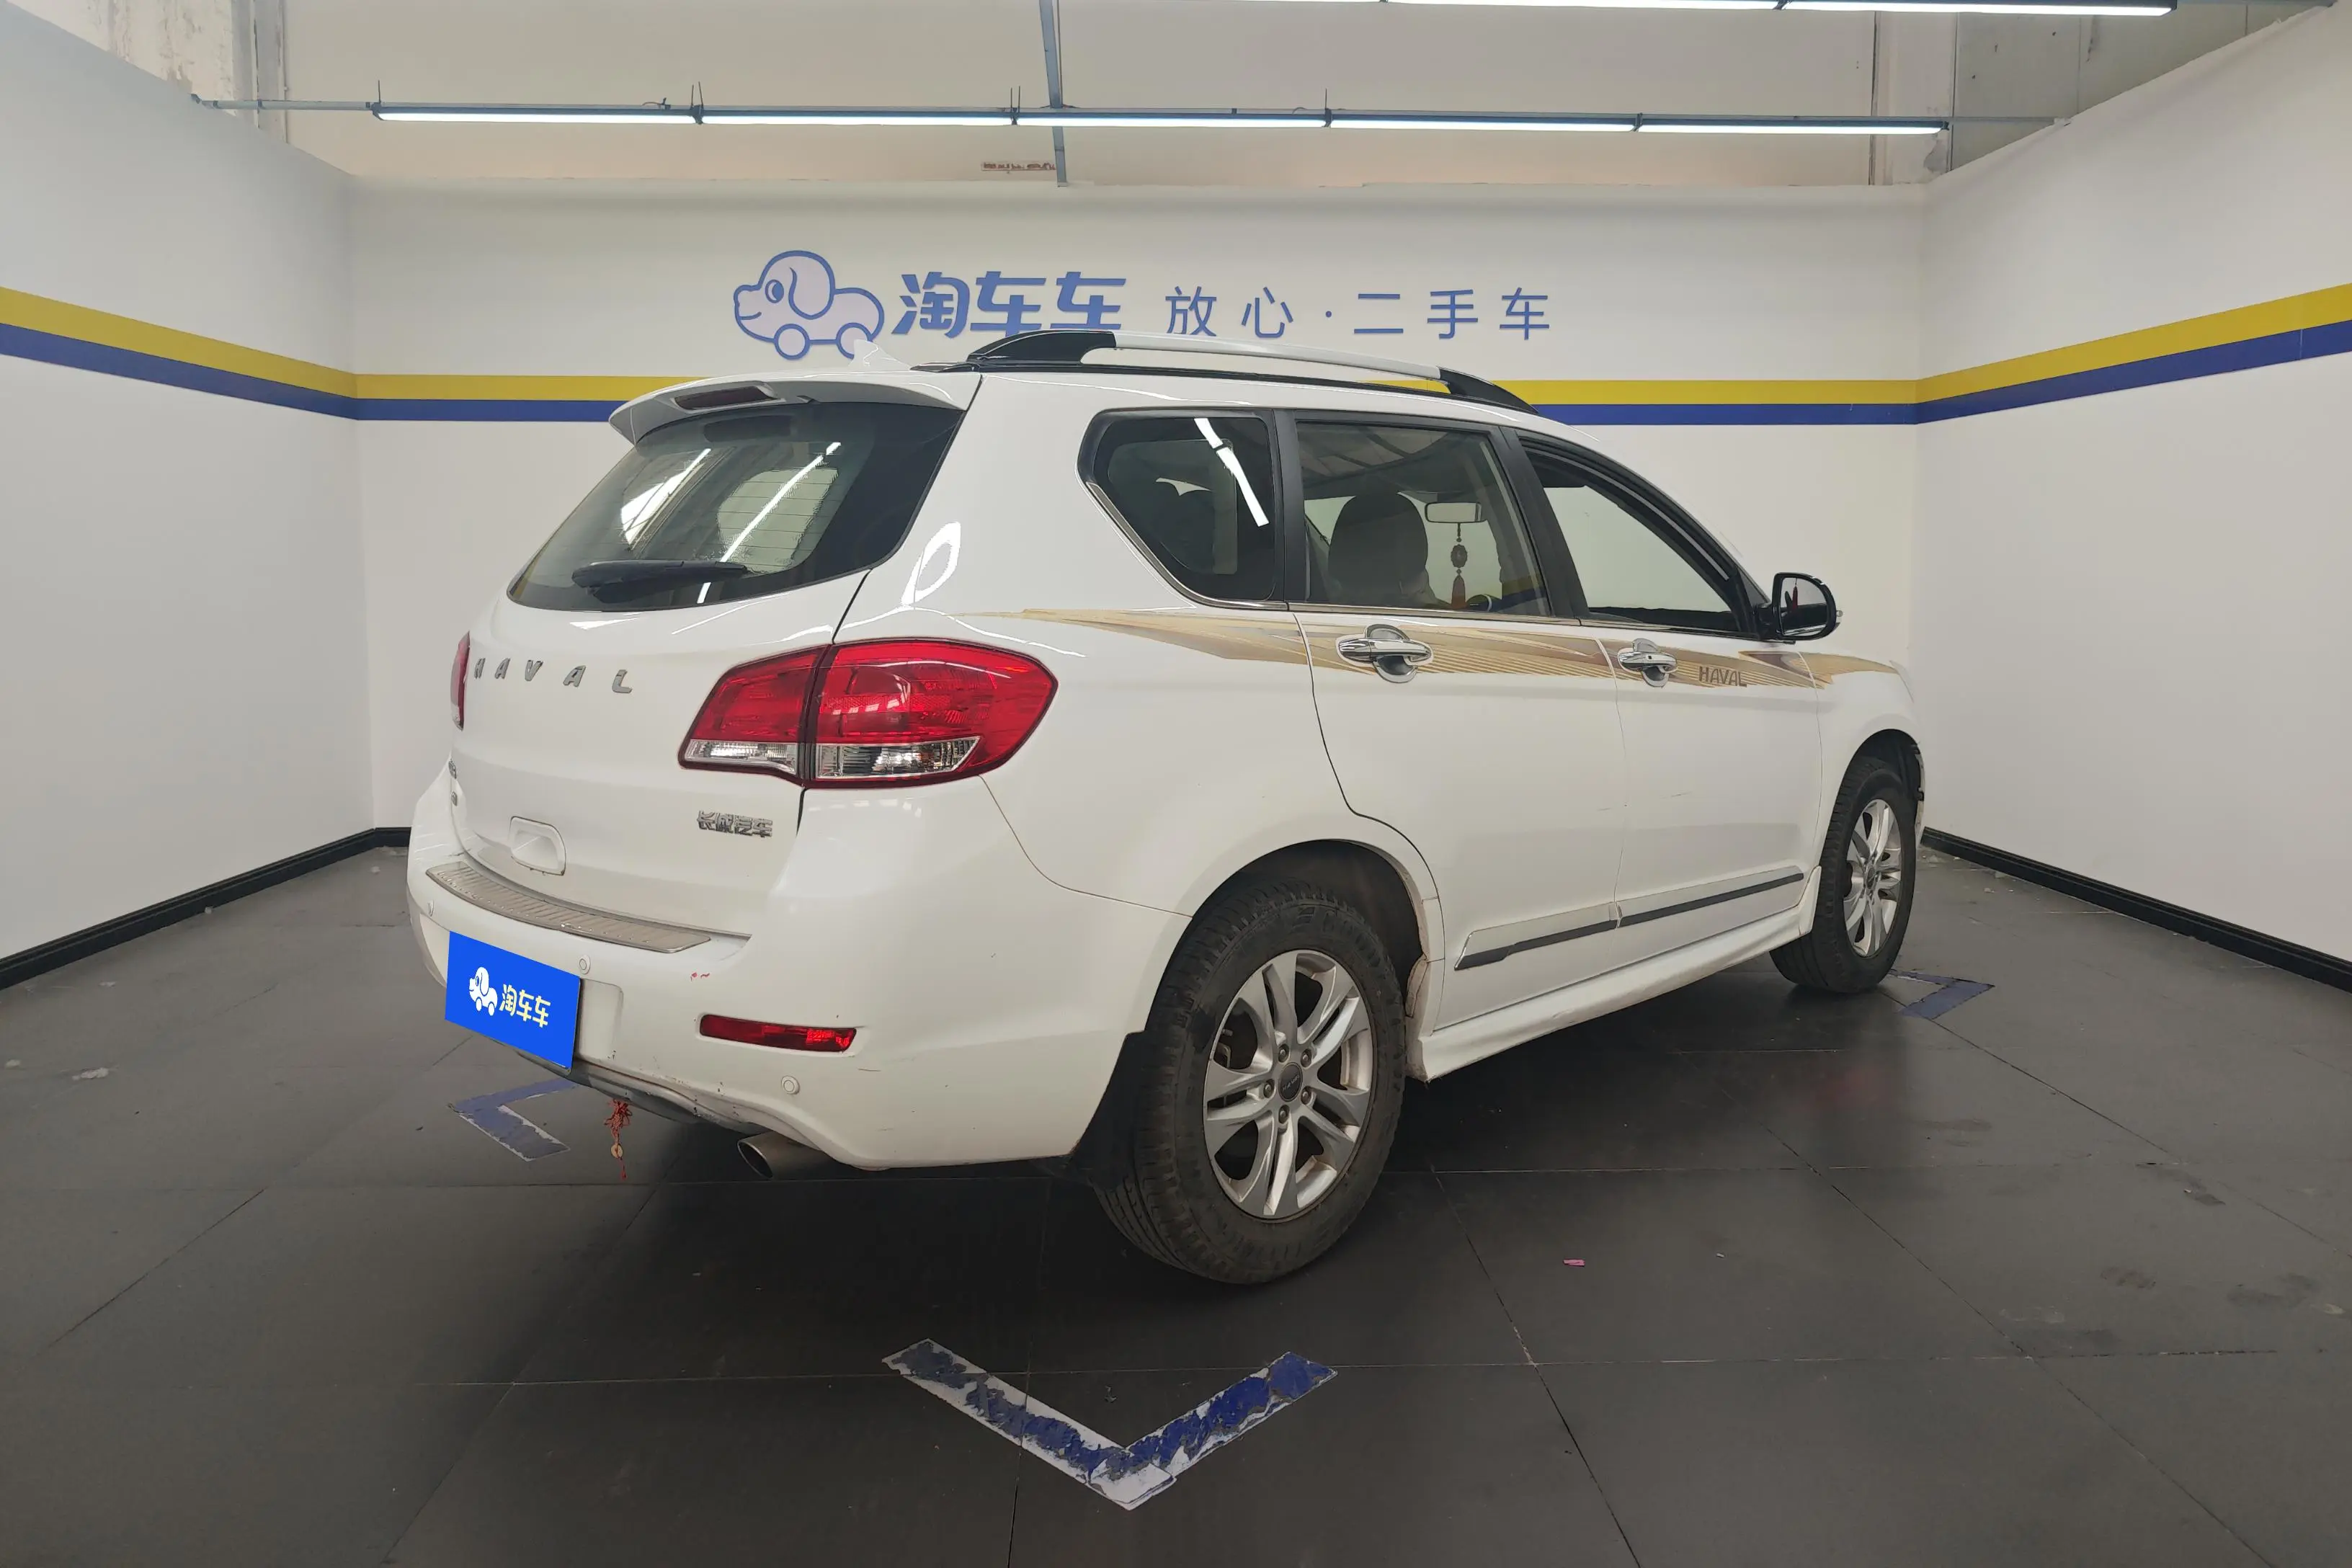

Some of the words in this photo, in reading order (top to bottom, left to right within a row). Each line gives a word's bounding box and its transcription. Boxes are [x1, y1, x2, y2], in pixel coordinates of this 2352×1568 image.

[891, 271, 1126, 339] 淘车车
[474, 657, 633, 694] HAVAL
[1699, 666, 1747, 687] HAVAL
